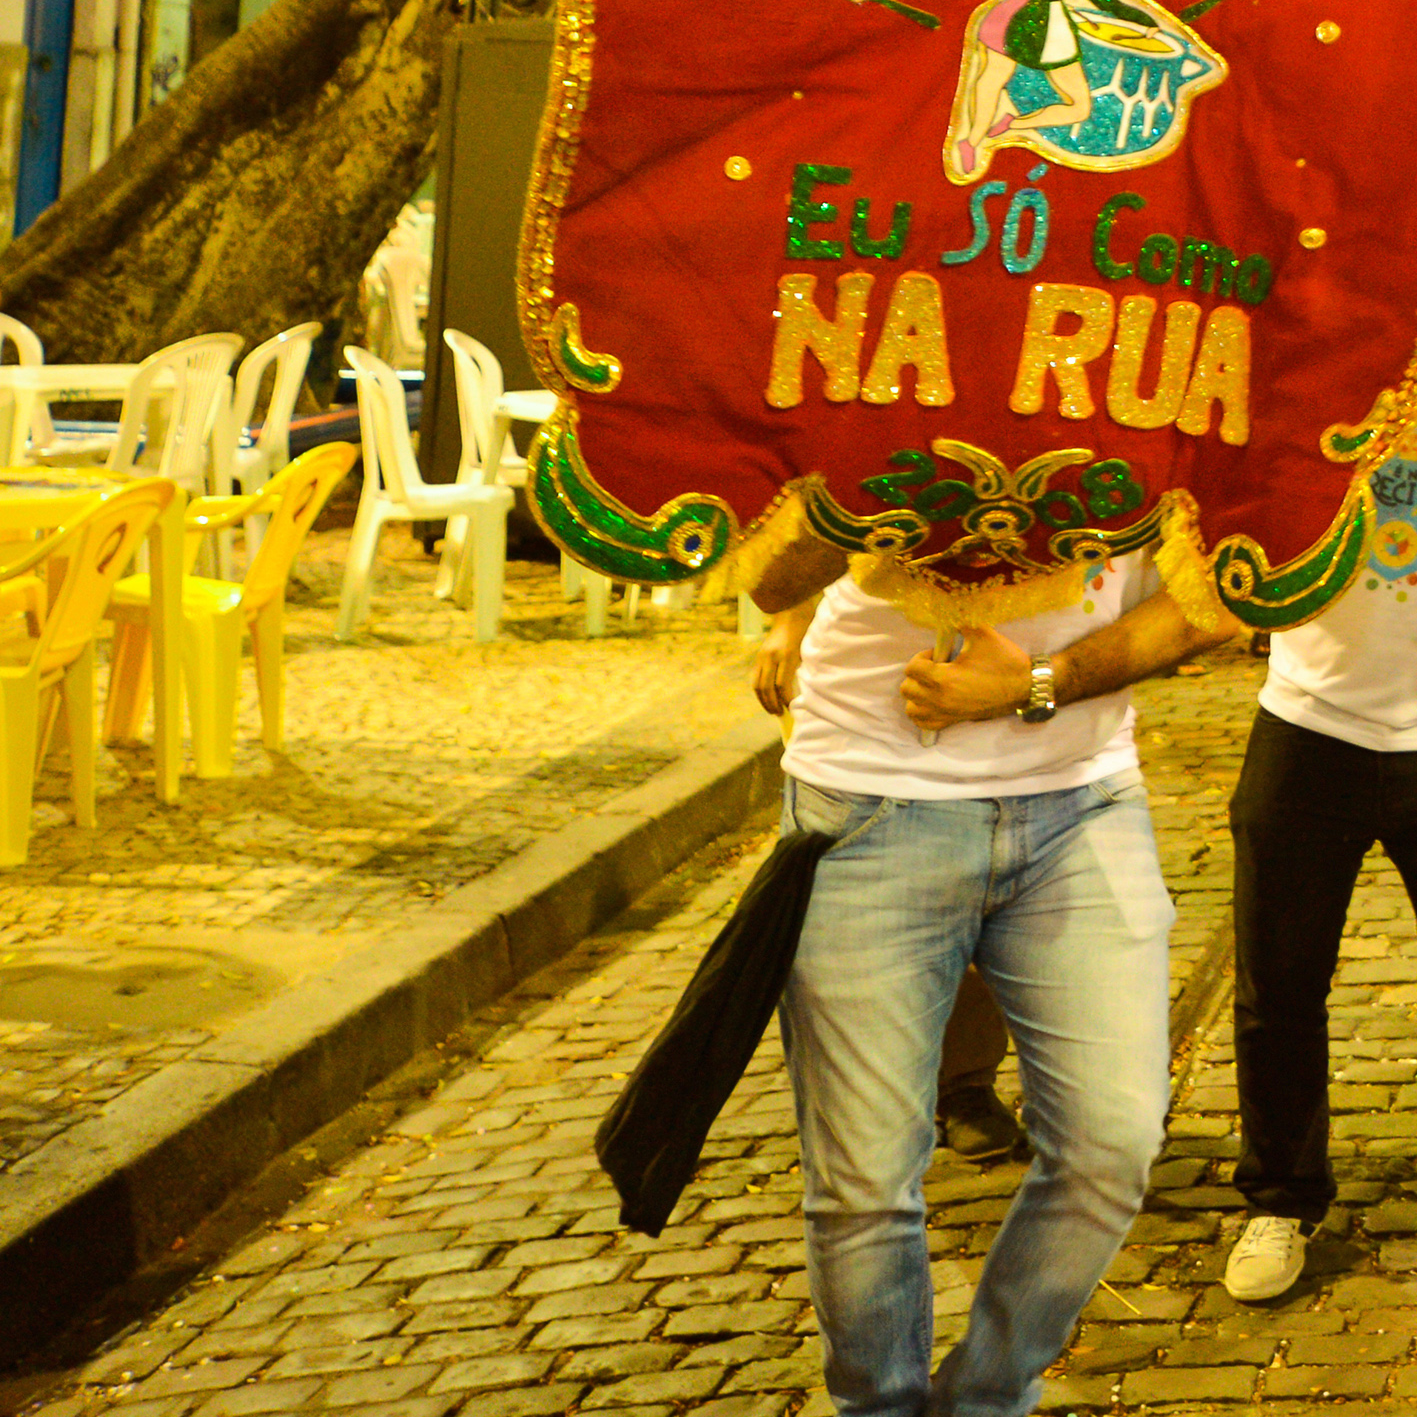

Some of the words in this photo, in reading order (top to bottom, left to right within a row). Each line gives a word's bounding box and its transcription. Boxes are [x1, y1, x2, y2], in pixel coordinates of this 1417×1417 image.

[784, 163, 914, 261] Eu
[1092, 190, 1274, 306] Como
[764, 270, 956, 411] NA
[1008, 281, 1253, 447] RUA
